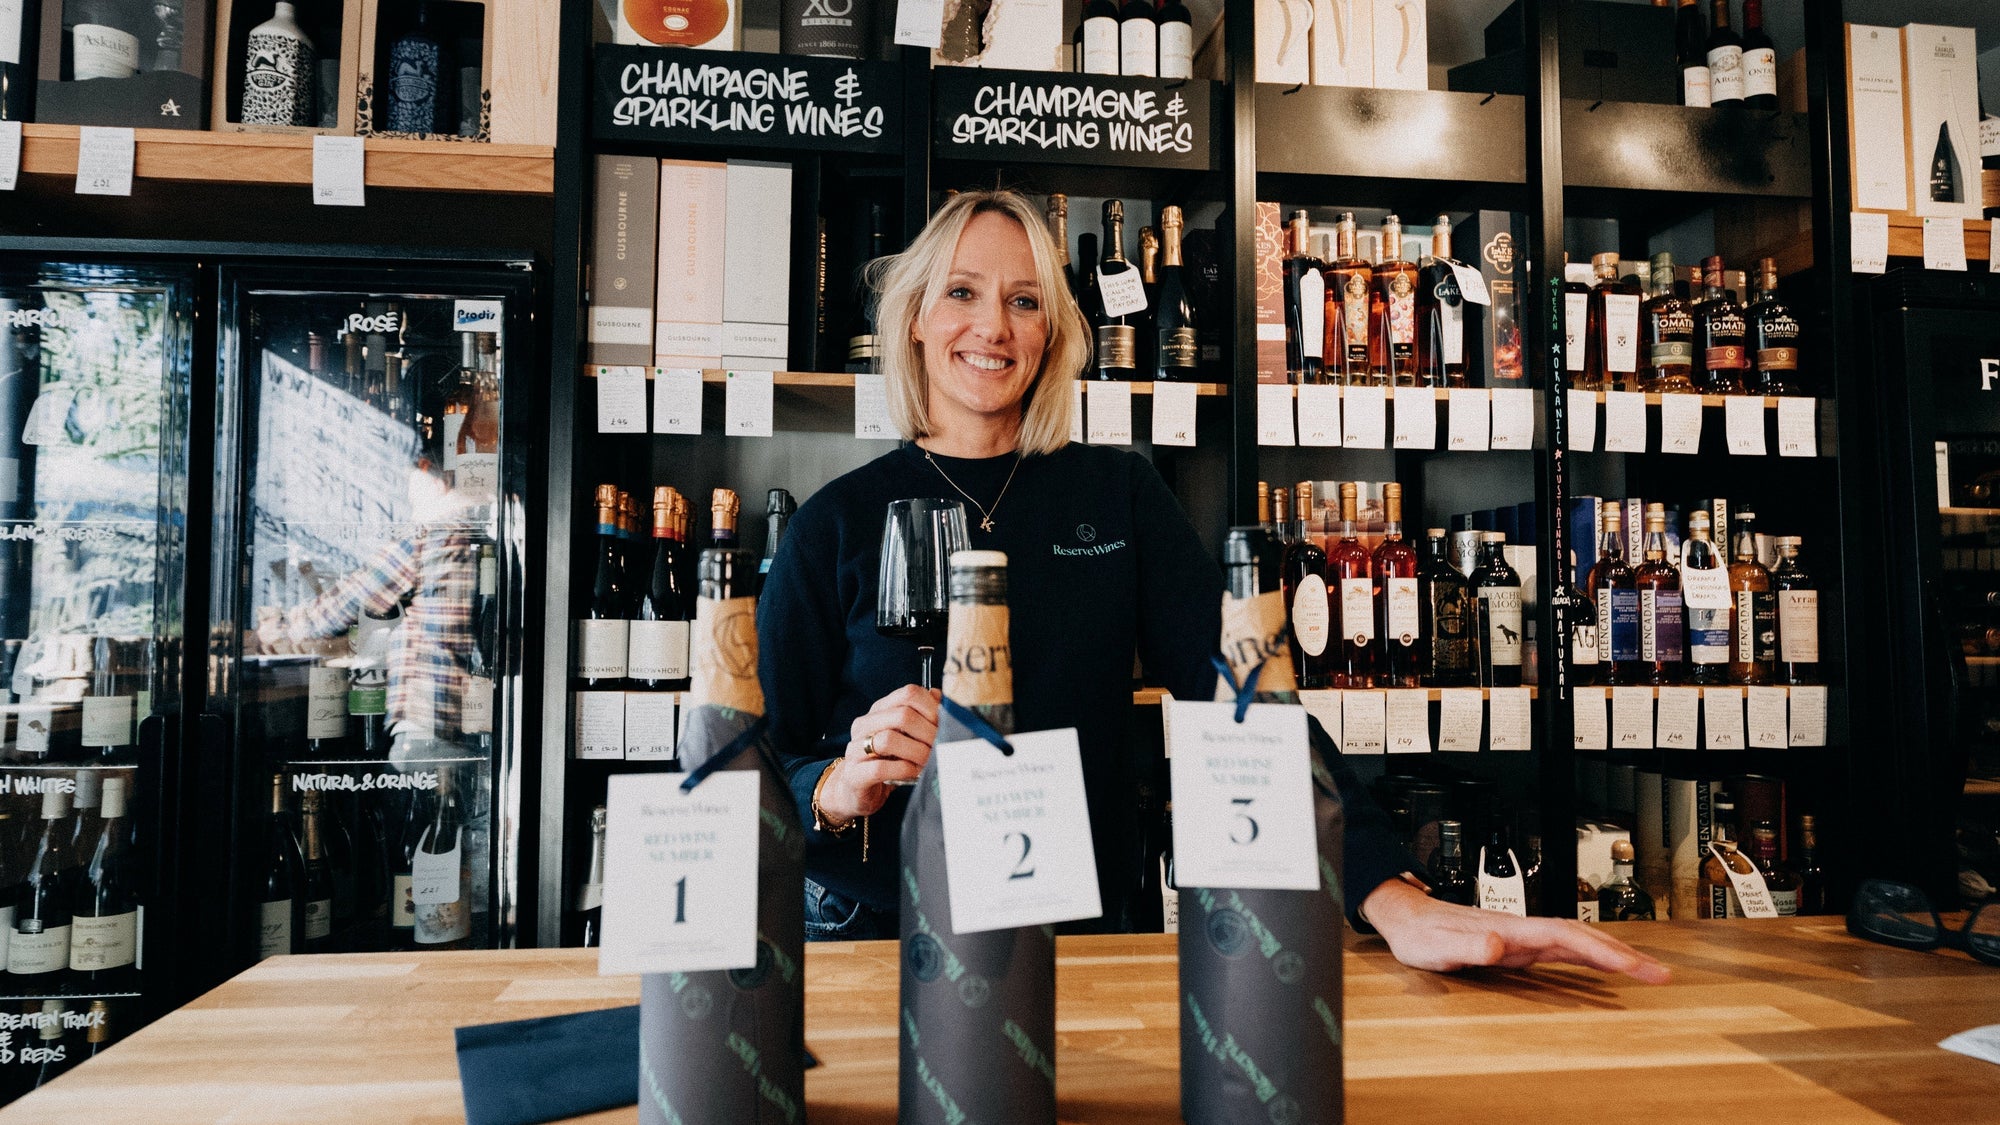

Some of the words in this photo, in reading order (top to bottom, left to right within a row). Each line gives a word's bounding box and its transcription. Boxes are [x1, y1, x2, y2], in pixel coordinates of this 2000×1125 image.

[620, 60, 809, 100] CHAMPAGNE
[834, 68, 863, 106] &
[974, 82, 1159, 123] CHAMPAGNE
[1164, 92, 1189, 124] &
[612, 97, 775, 133] SPARKLING
[785, 101, 884, 138] WINES
[952, 114, 1100, 149] SPARKLING
[1109, 120, 1193, 153] WINES
[617, 190, 628, 260] GUSBOURNE
[687, 202, 697, 276] GUSBOURNE
[457, 309, 497, 320] Prodis
[597, 320, 642, 329] GUSBOURNE
[667, 334, 711, 342] GUSBOURNE
[734, 335, 777, 343] GUSBOURNE
[1553, 357, 1562, 445] ORGANIC
[1555, 462, 1563, 583] SUSTAINABLE
[1631, 502, 1641, 568] LENCADAM
[1600, 592, 1609, 659] GLENCADAM
[1644, 593, 1653, 659] GLENCADAM
[1740, 593, 1750, 660] GLENCADAM
[1556, 608, 1566, 700] NATURAL
[15, 775, 76, 795] WHITES
[292, 773, 361, 792] NATURAL
[361, 774, 376, 792] &
[377, 771, 439, 790] ORANGE
[1229, 798, 1259, 846] 3
[1004, 832, 1036, 880] 2
[674, 875, 687, 924] 1
[0, 1010, 58, 1030] BEATEN
[60, 1010, 105, 1029] TRACK
[0, 1049, 15, 1064] D
[20, 1045, 66, 1064] REDS
